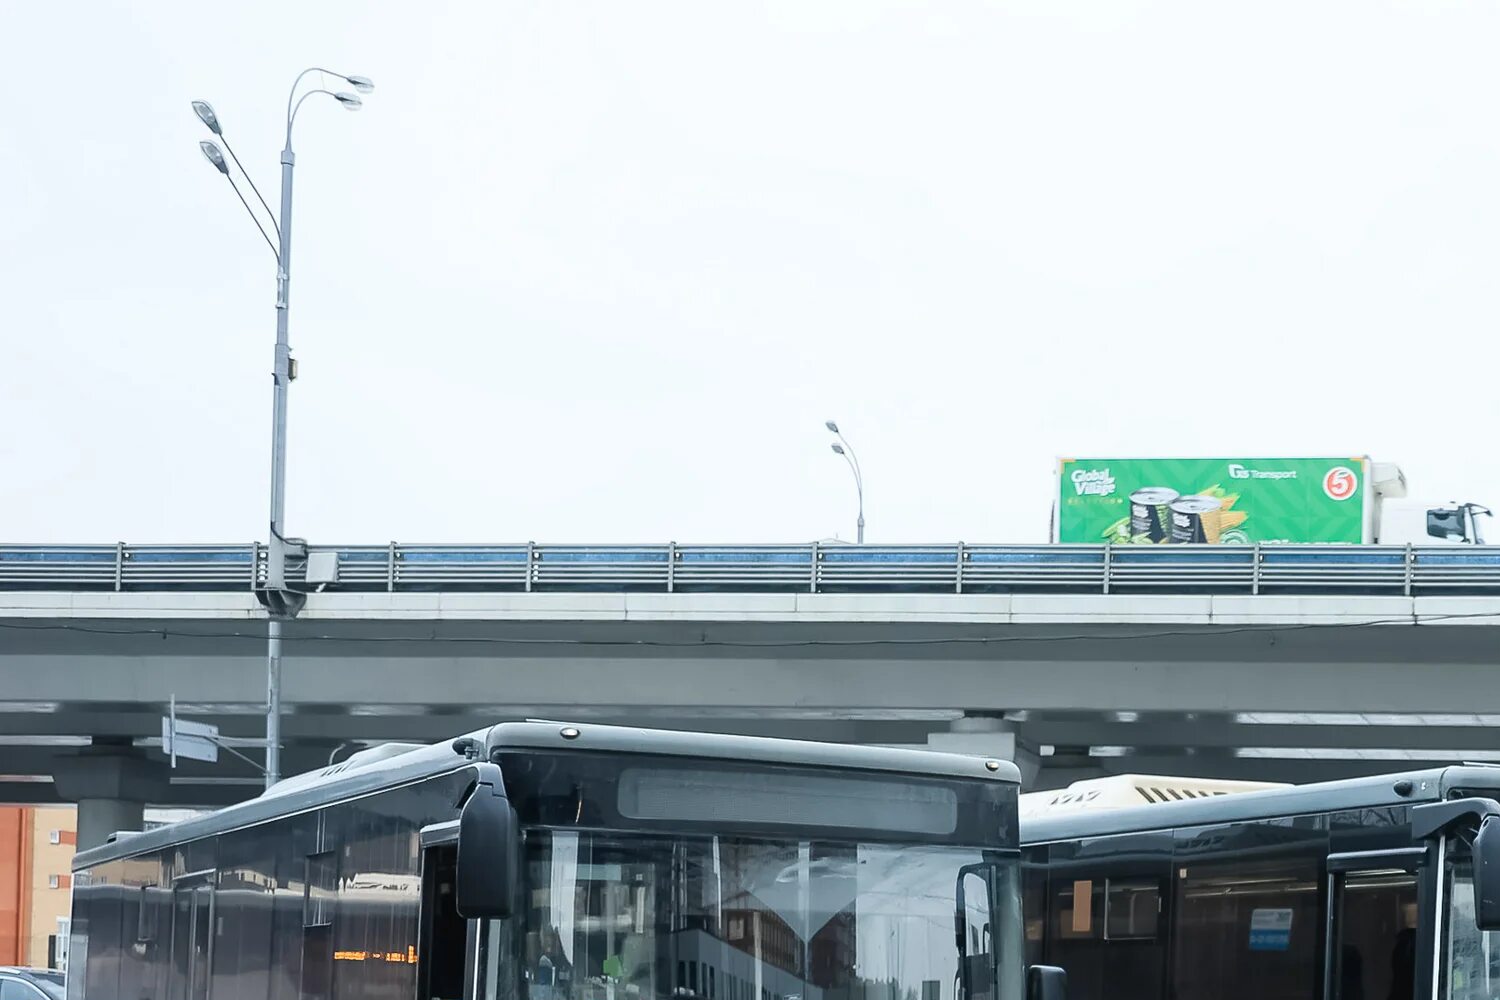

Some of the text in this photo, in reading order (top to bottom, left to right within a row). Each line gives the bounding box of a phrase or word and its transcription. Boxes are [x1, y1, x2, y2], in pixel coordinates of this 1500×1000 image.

[1071, 468, 1112, 483] Global
[1251, 470, 1297, 480] Transport
[1331, 469, 1350, 496] 5
[1075, 481, 1116, 497] Village
